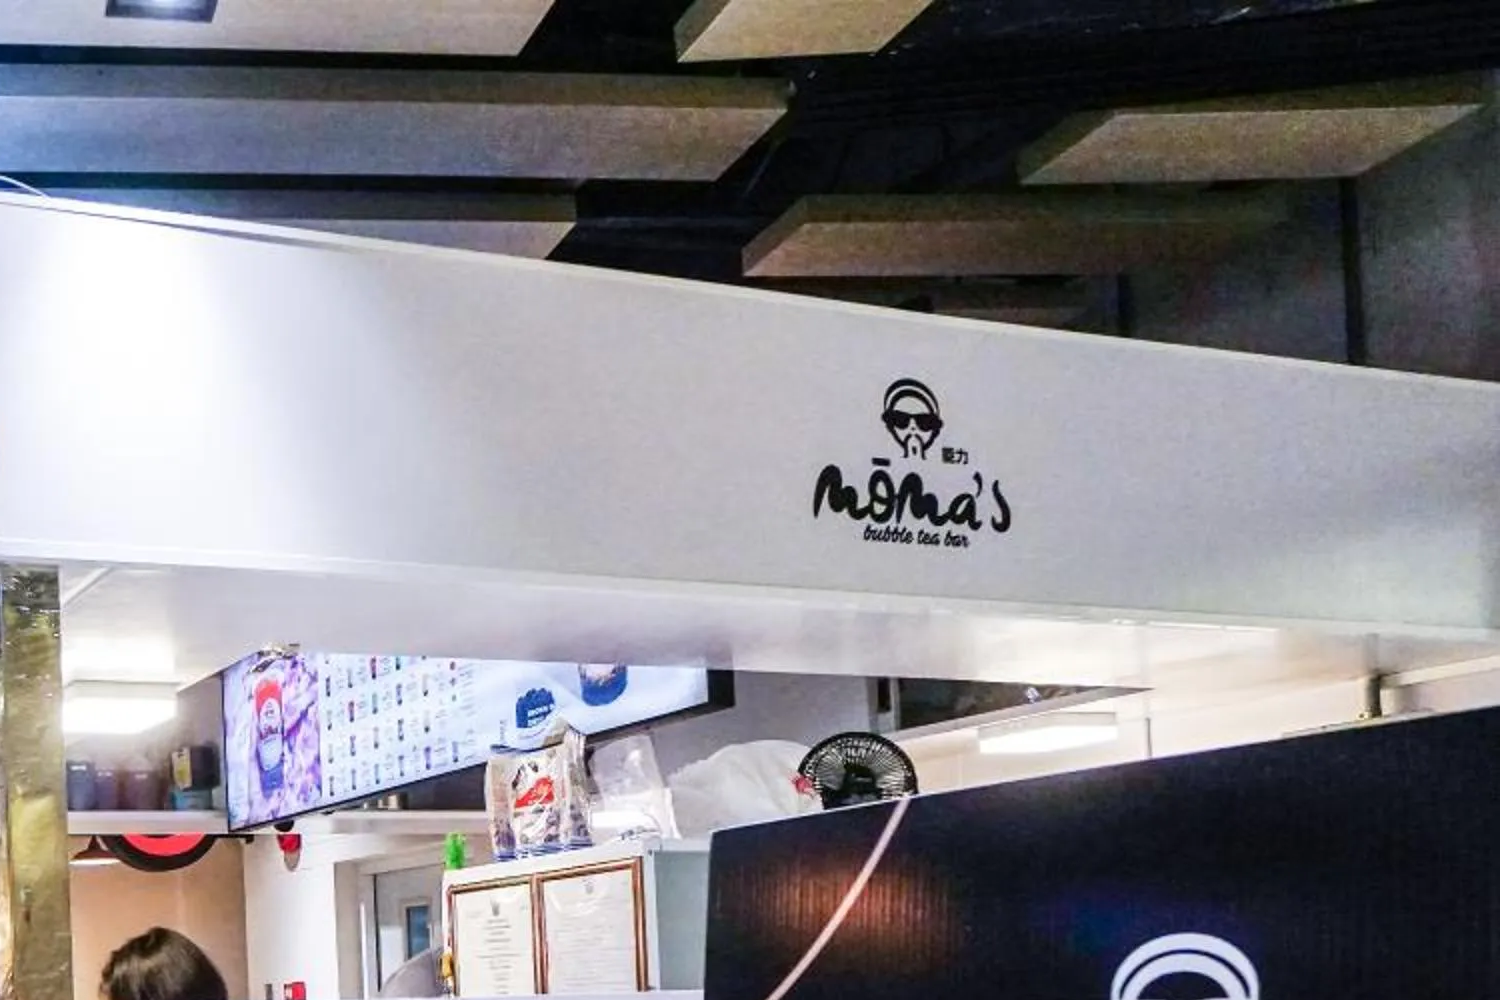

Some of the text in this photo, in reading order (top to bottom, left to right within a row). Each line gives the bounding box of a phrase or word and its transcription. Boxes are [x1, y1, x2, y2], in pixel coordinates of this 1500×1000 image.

[863, 524, 970, 549] bubble tea bar
